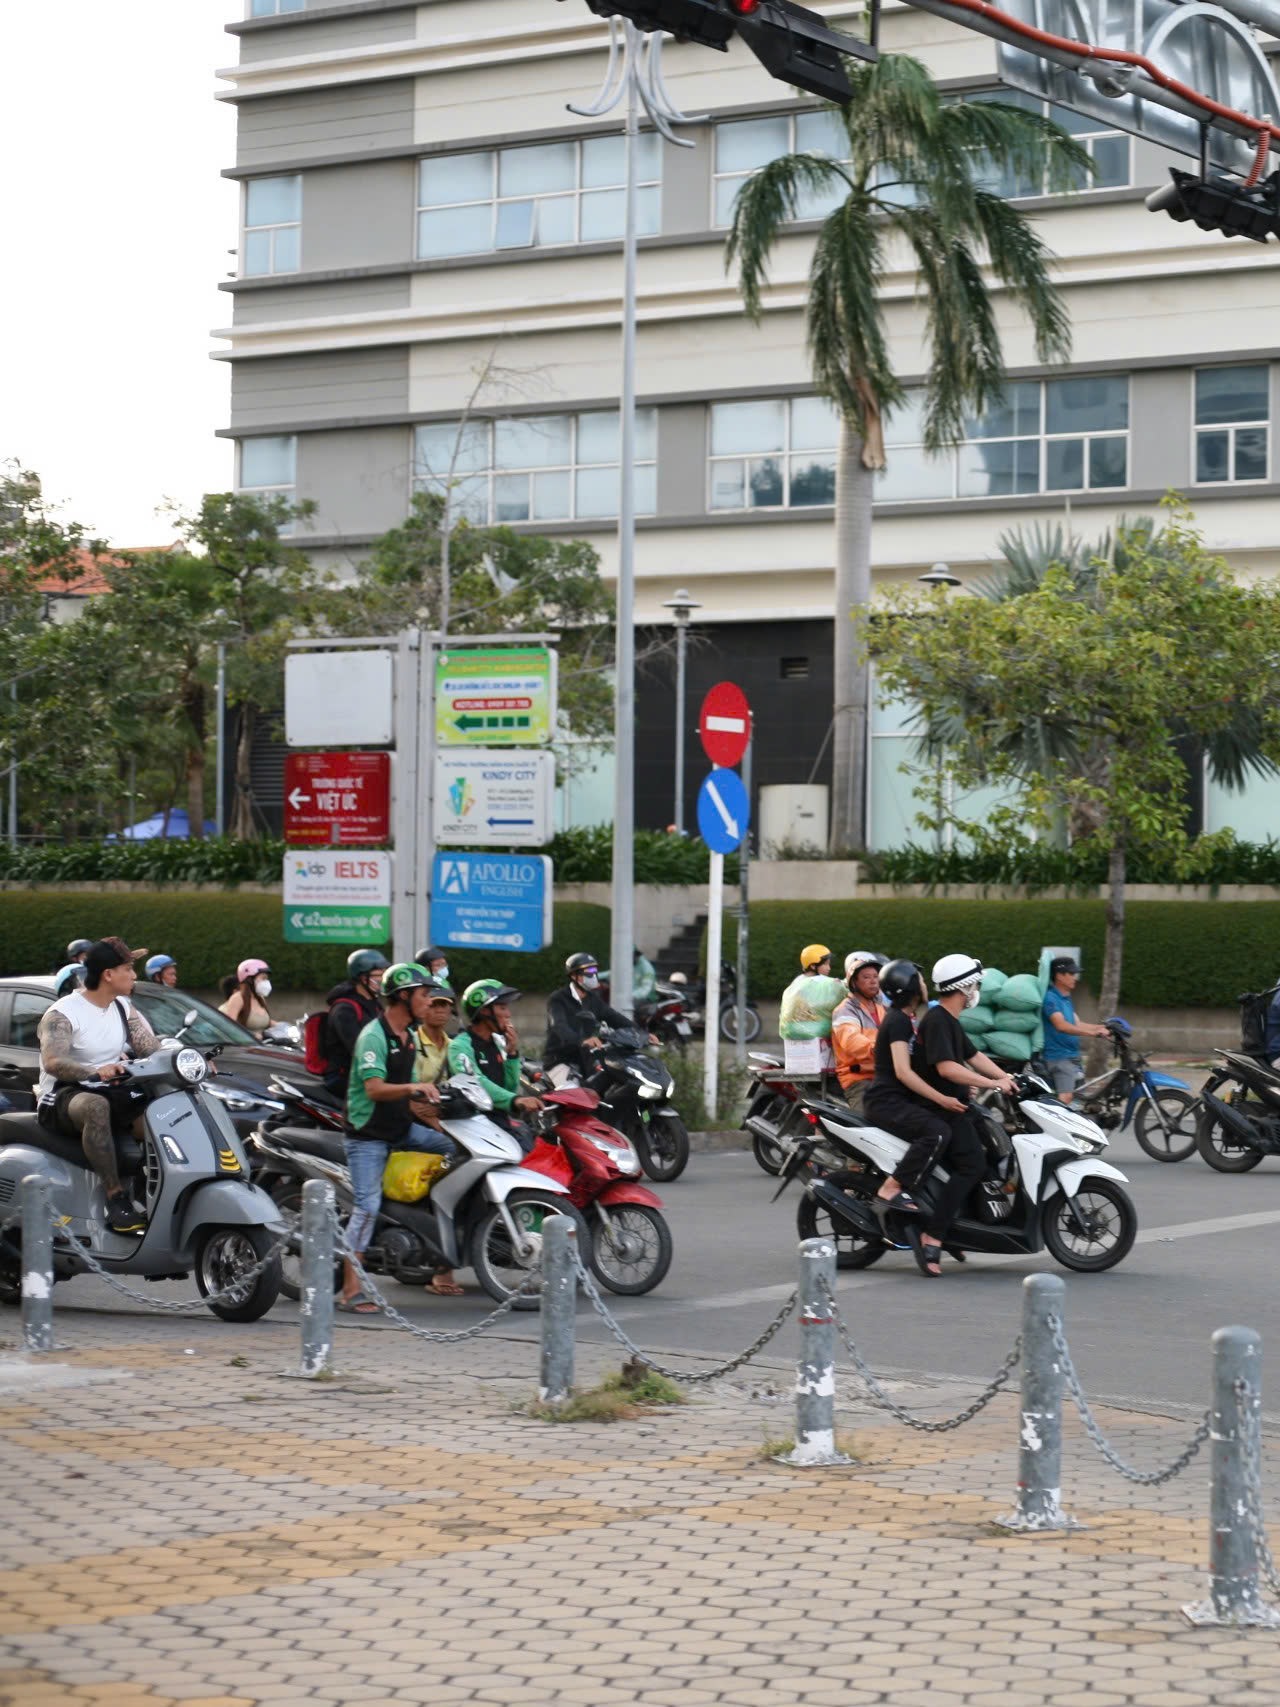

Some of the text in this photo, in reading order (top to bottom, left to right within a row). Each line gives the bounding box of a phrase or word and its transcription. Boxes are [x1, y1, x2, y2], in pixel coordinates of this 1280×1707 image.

[482, 771, 536, 780] KINDY CITY
[316, 790, 341, 812] VIỆT
[334, 861, 379, 879] IELTS
[472, 863, 536, 882] APOLLO
[480, 886, 524, 897] ENGLISH
